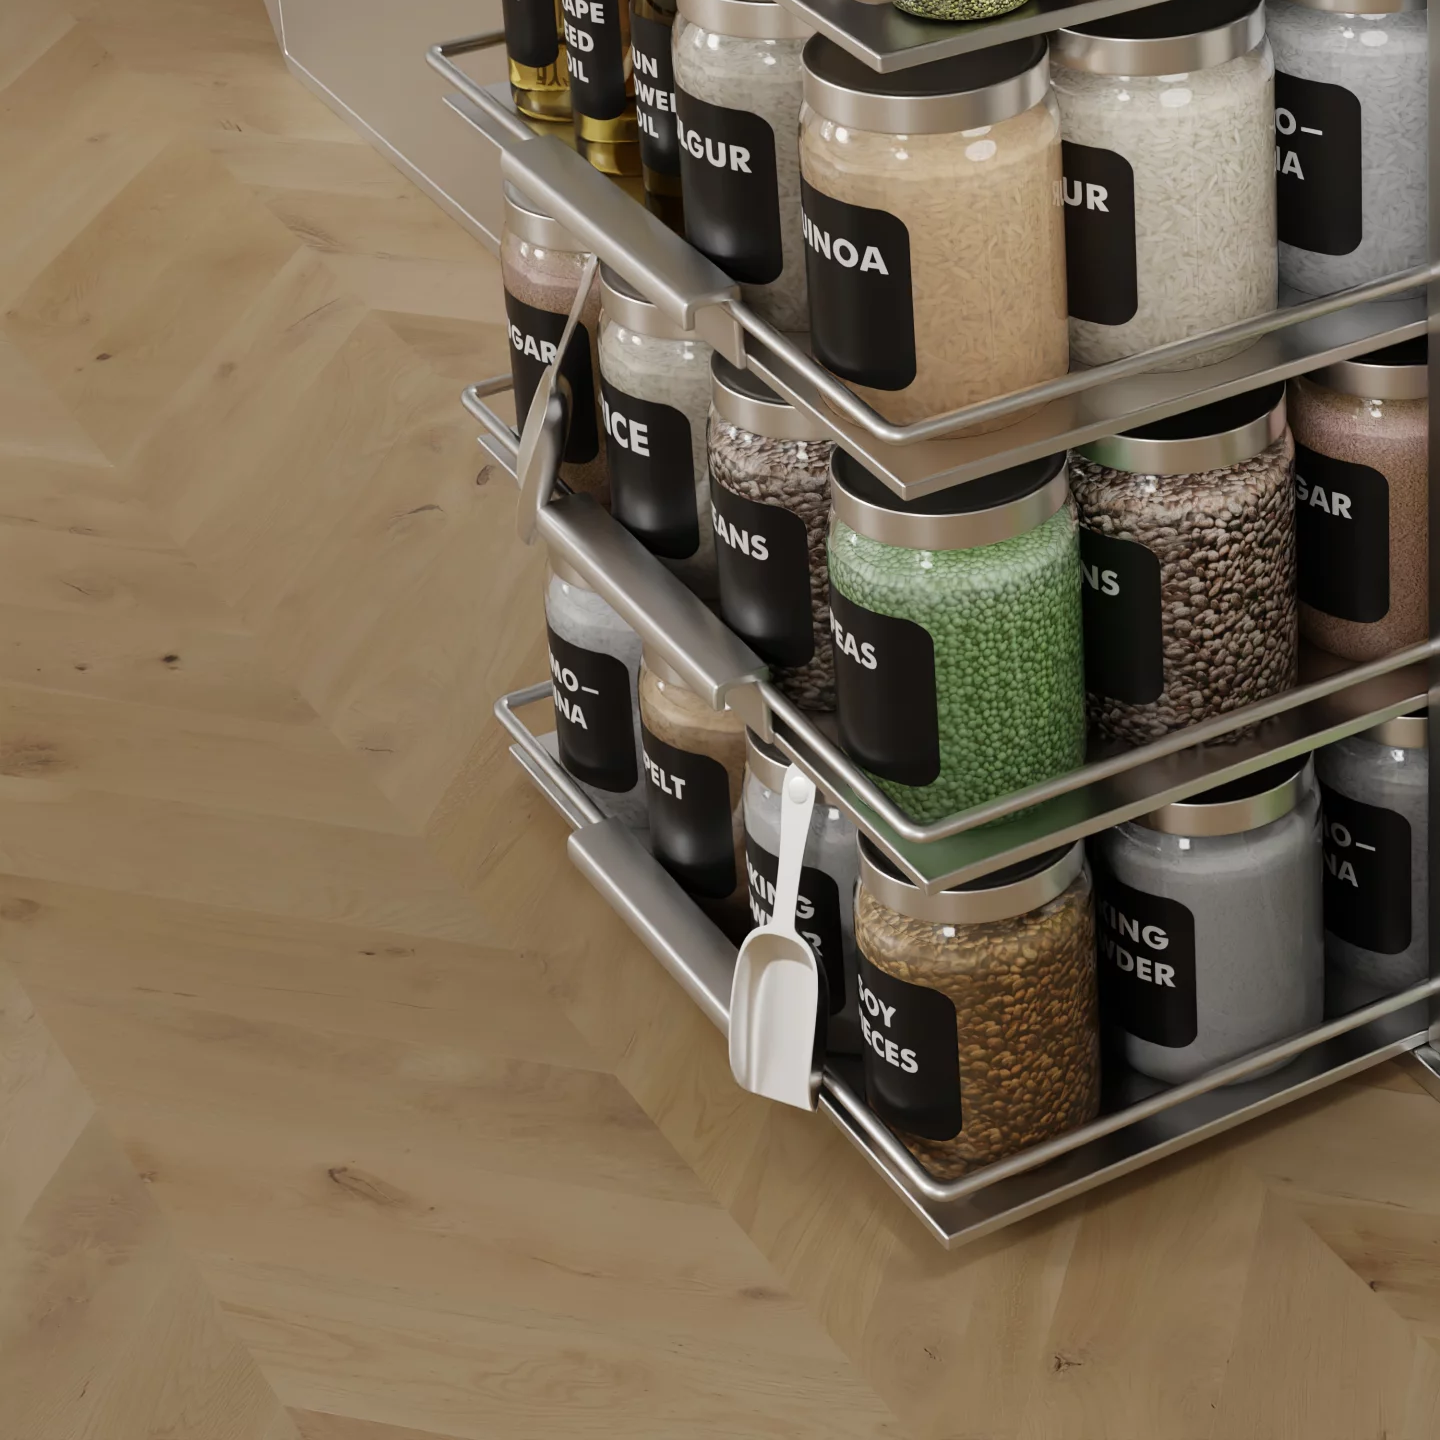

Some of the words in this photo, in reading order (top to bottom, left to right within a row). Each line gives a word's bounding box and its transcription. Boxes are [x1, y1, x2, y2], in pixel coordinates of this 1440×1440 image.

[563, 18, 595, 53] EED
[631, 43, 658, 79] UN
[1275, 107, 1323, 136] O-
[1062, 176, 1110, 213] UR
[1296, 474, 1353, 520] GAR
[711, 501, 770, 561] EANS
[1081, 559, 1121, 597] NS
